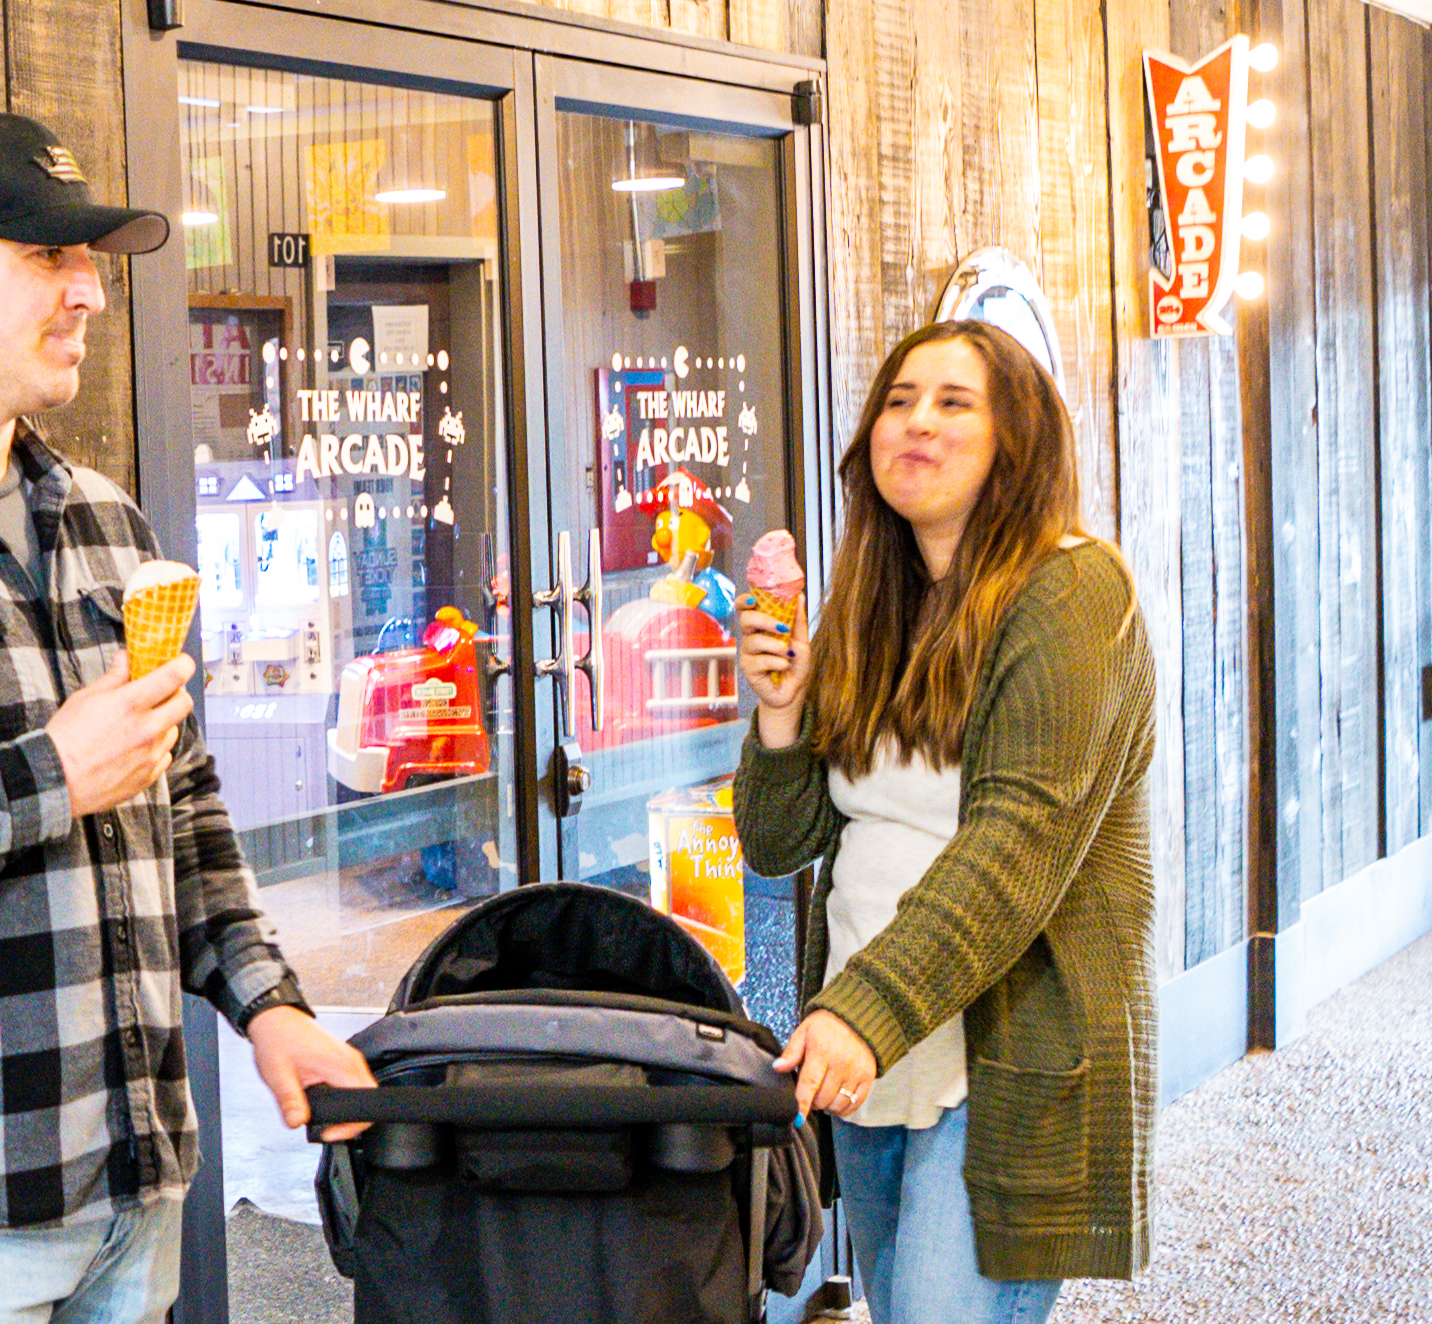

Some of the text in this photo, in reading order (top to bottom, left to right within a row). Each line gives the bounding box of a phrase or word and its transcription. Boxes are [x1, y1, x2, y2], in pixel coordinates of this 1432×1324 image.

[1164, 75, 1223, 300] ARCADE
[296, 389, 421, 423] THE WHARF
[636, 390, 726, 419] THE WHARF
[295, 433, 426, 484] ARCADE
[636, 426, 730, 472] ARCADE
